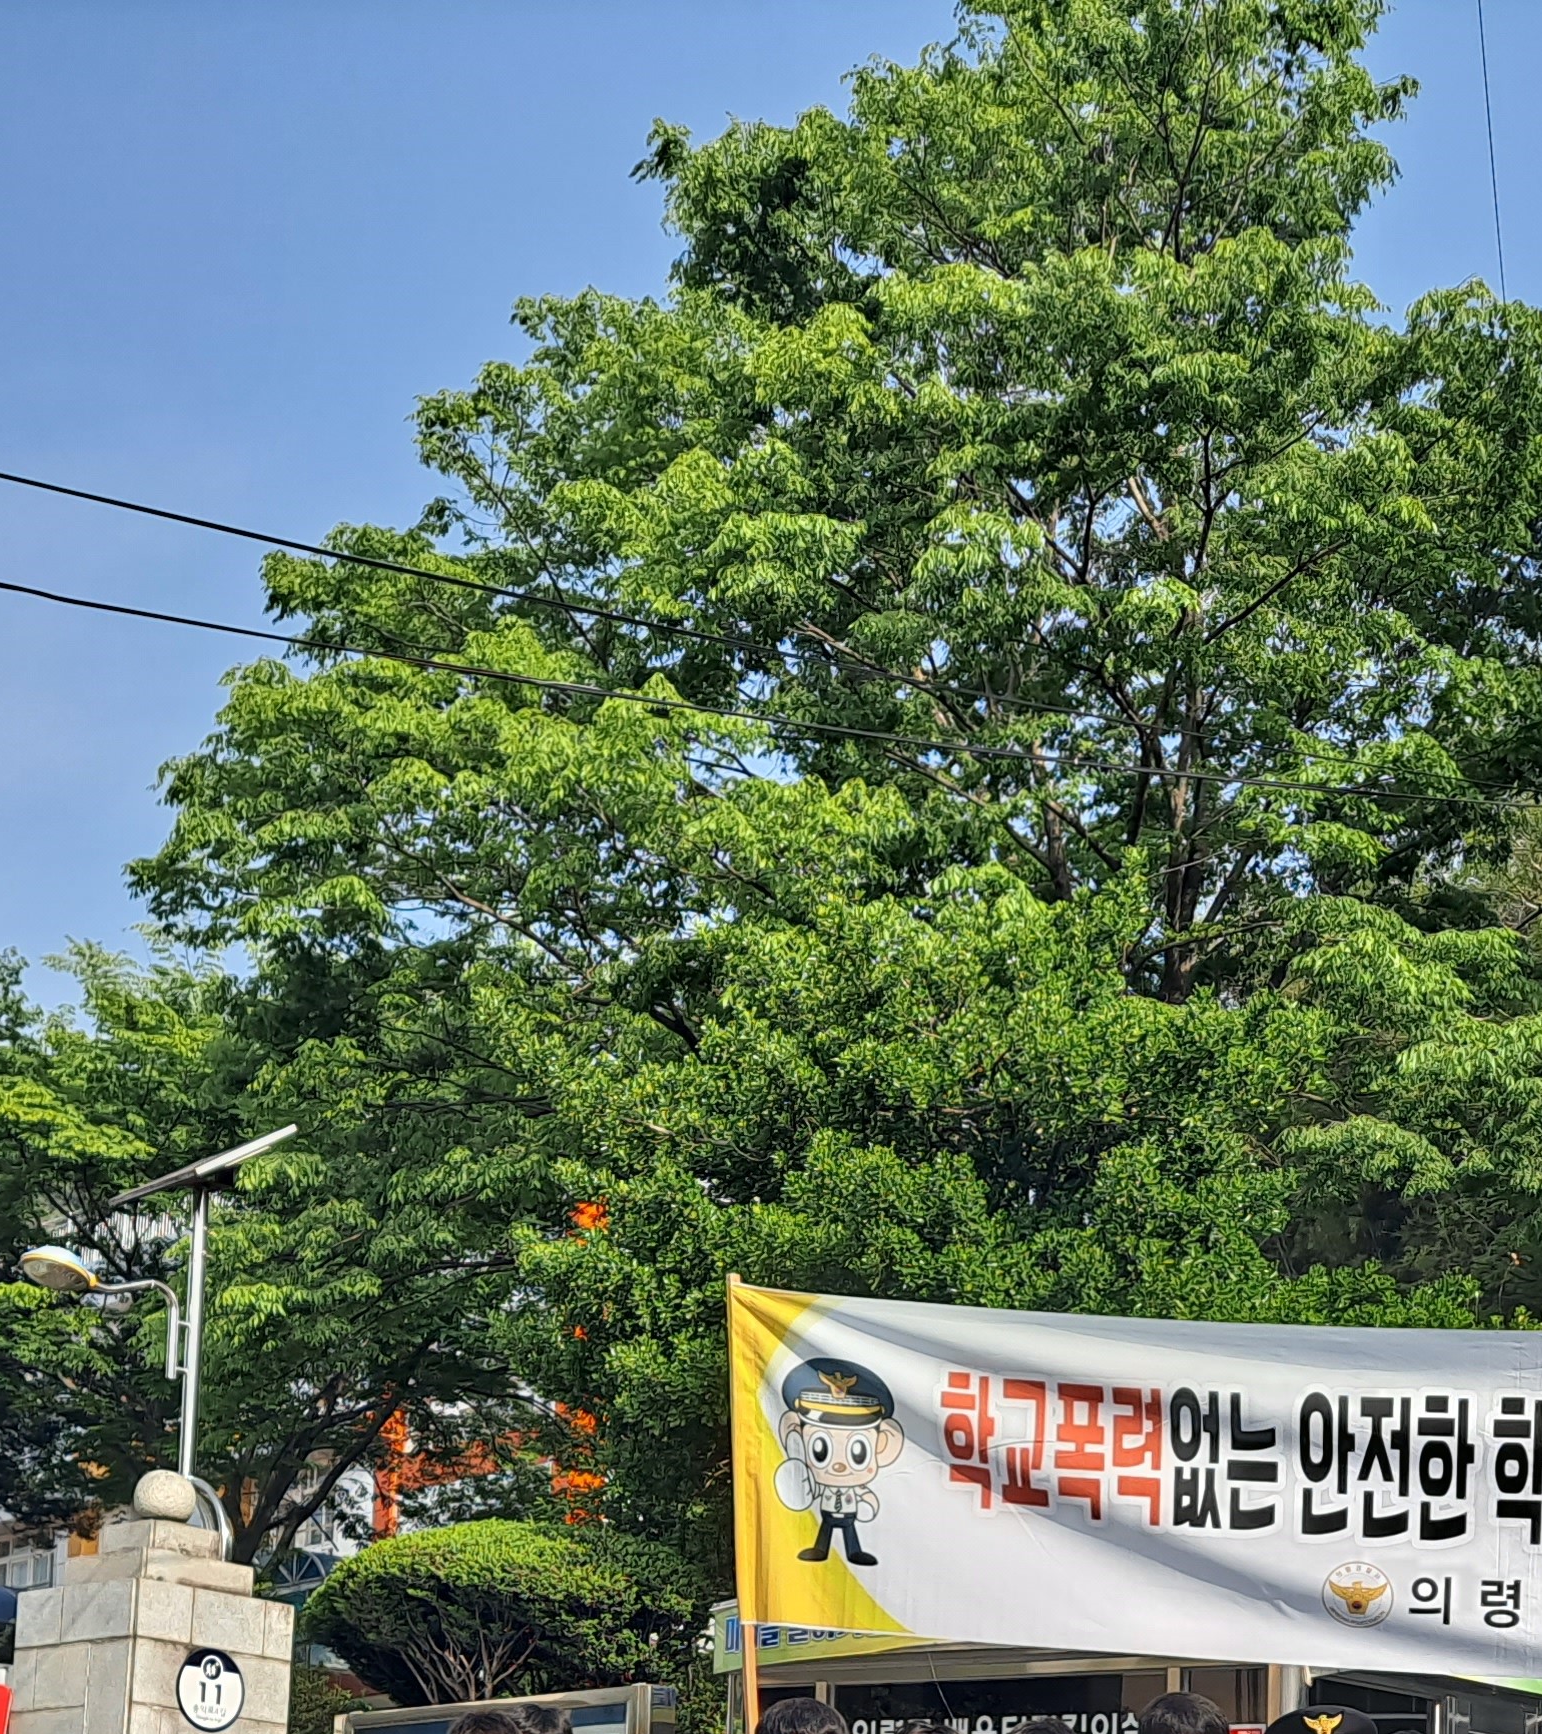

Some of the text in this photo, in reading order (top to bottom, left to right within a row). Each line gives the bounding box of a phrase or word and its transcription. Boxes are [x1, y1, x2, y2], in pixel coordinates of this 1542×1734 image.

[940, 1371, 1278, 1530] 학교폭력없는
[1299, 1390, 1475, 1542] 안전한
[198, 1680, 222, 1705] 11
